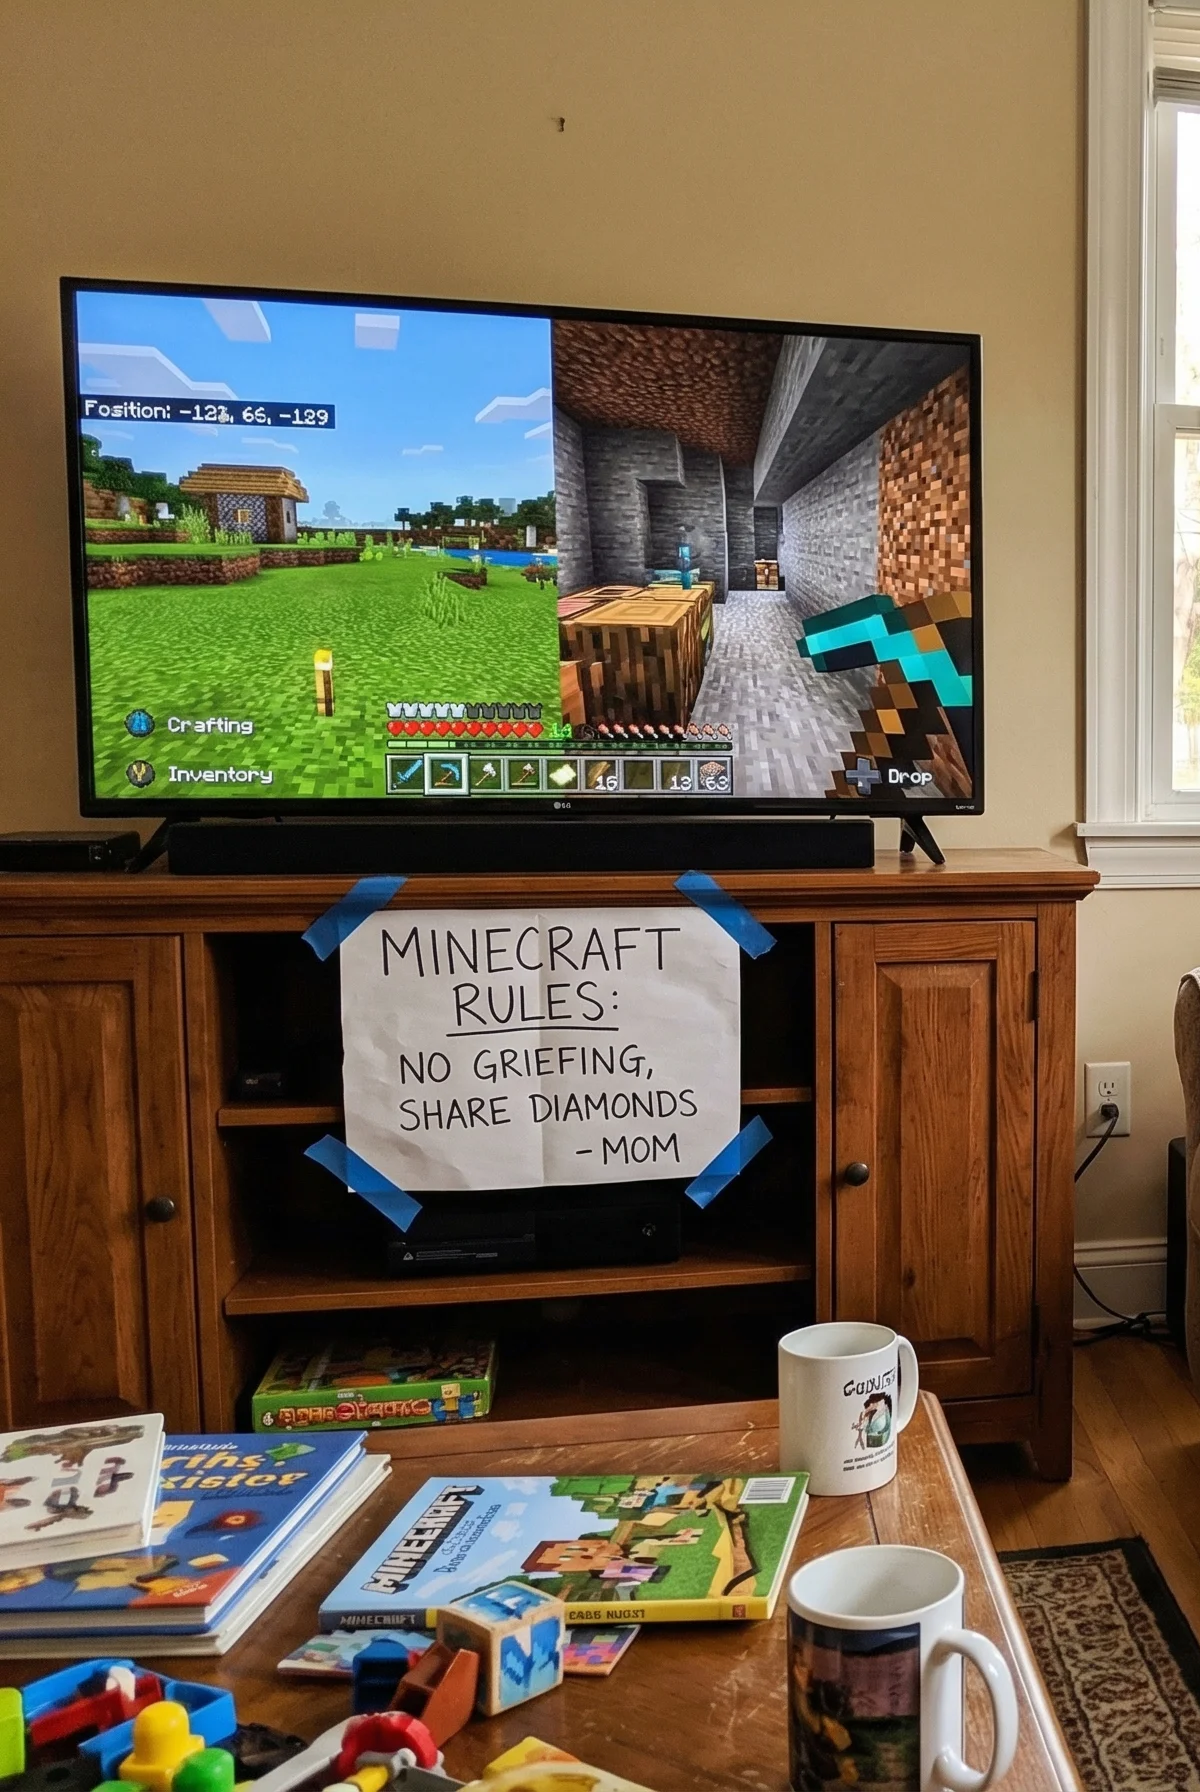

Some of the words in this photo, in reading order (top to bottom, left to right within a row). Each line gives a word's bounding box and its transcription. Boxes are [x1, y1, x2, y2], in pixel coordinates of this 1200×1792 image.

[84, 399, 171, 420] Position:
[242, 407, 272, 425] 66,
[279, 409, 329, 426] -129
[167, 716, 253, 735] Crafting
[168, 766, 273, 784] Inventory
[595, 776, 618, 791] 16
[669, 777, 692, 791] 13
[705, 776, 730, 791] 63
[888, 768, 933, 786] Drop
[381, 925, 681, 978] MINECRAFT
[453, 981, 619, 1026] RULES:
[400, 1052, 450, 1084] NO
[473, 1044, 653, 1082] GRIEFING,
[399, 1096, 511, 1131] SHARE
[528, 1089, 698, 1122] DIAMONDS
[576, 1134, 681, 1165] -MOM
[360, 1485, 485, 1595] MINECRAFT
